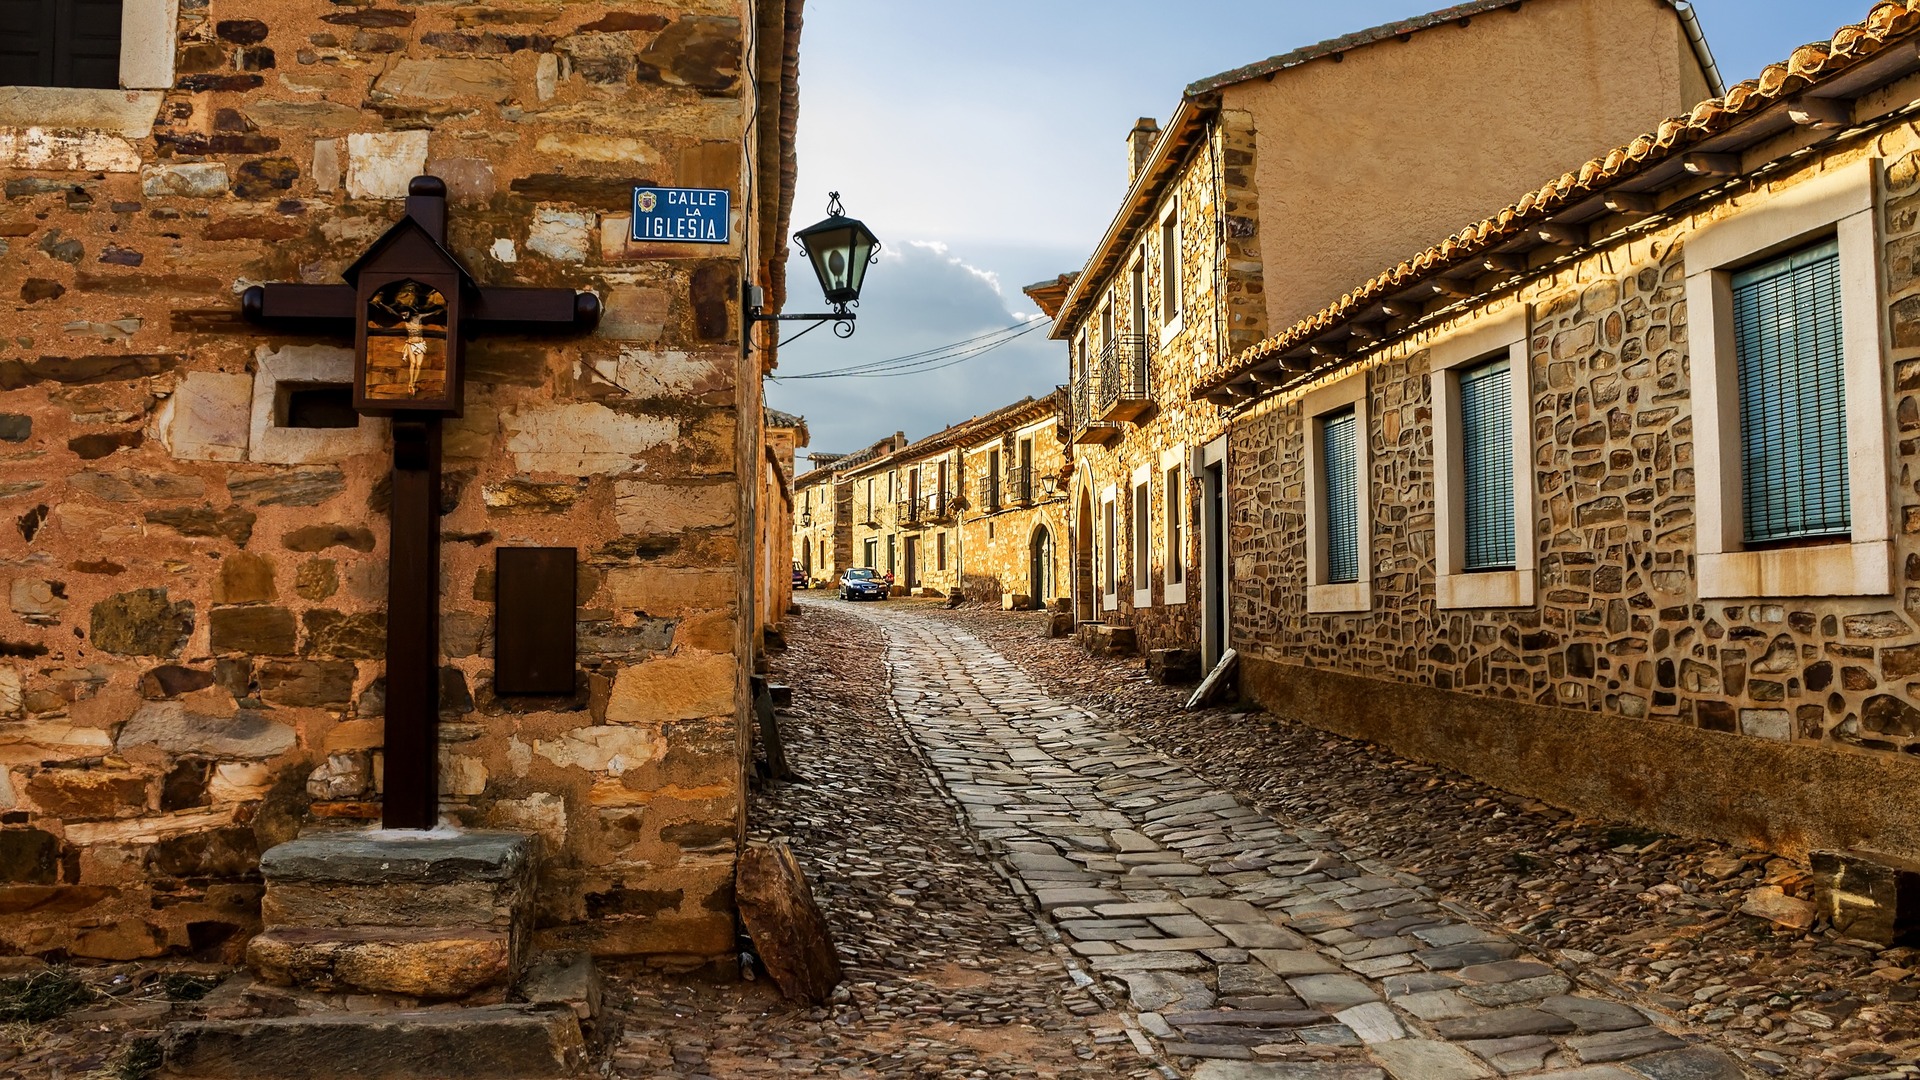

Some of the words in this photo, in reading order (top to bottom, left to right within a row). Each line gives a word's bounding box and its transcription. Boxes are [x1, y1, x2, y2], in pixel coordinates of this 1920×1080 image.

[668, 191, 717, 206] CALLE
[685, 207, 701, 217] LA
[645, 217, 716, 239] IGLESIA
